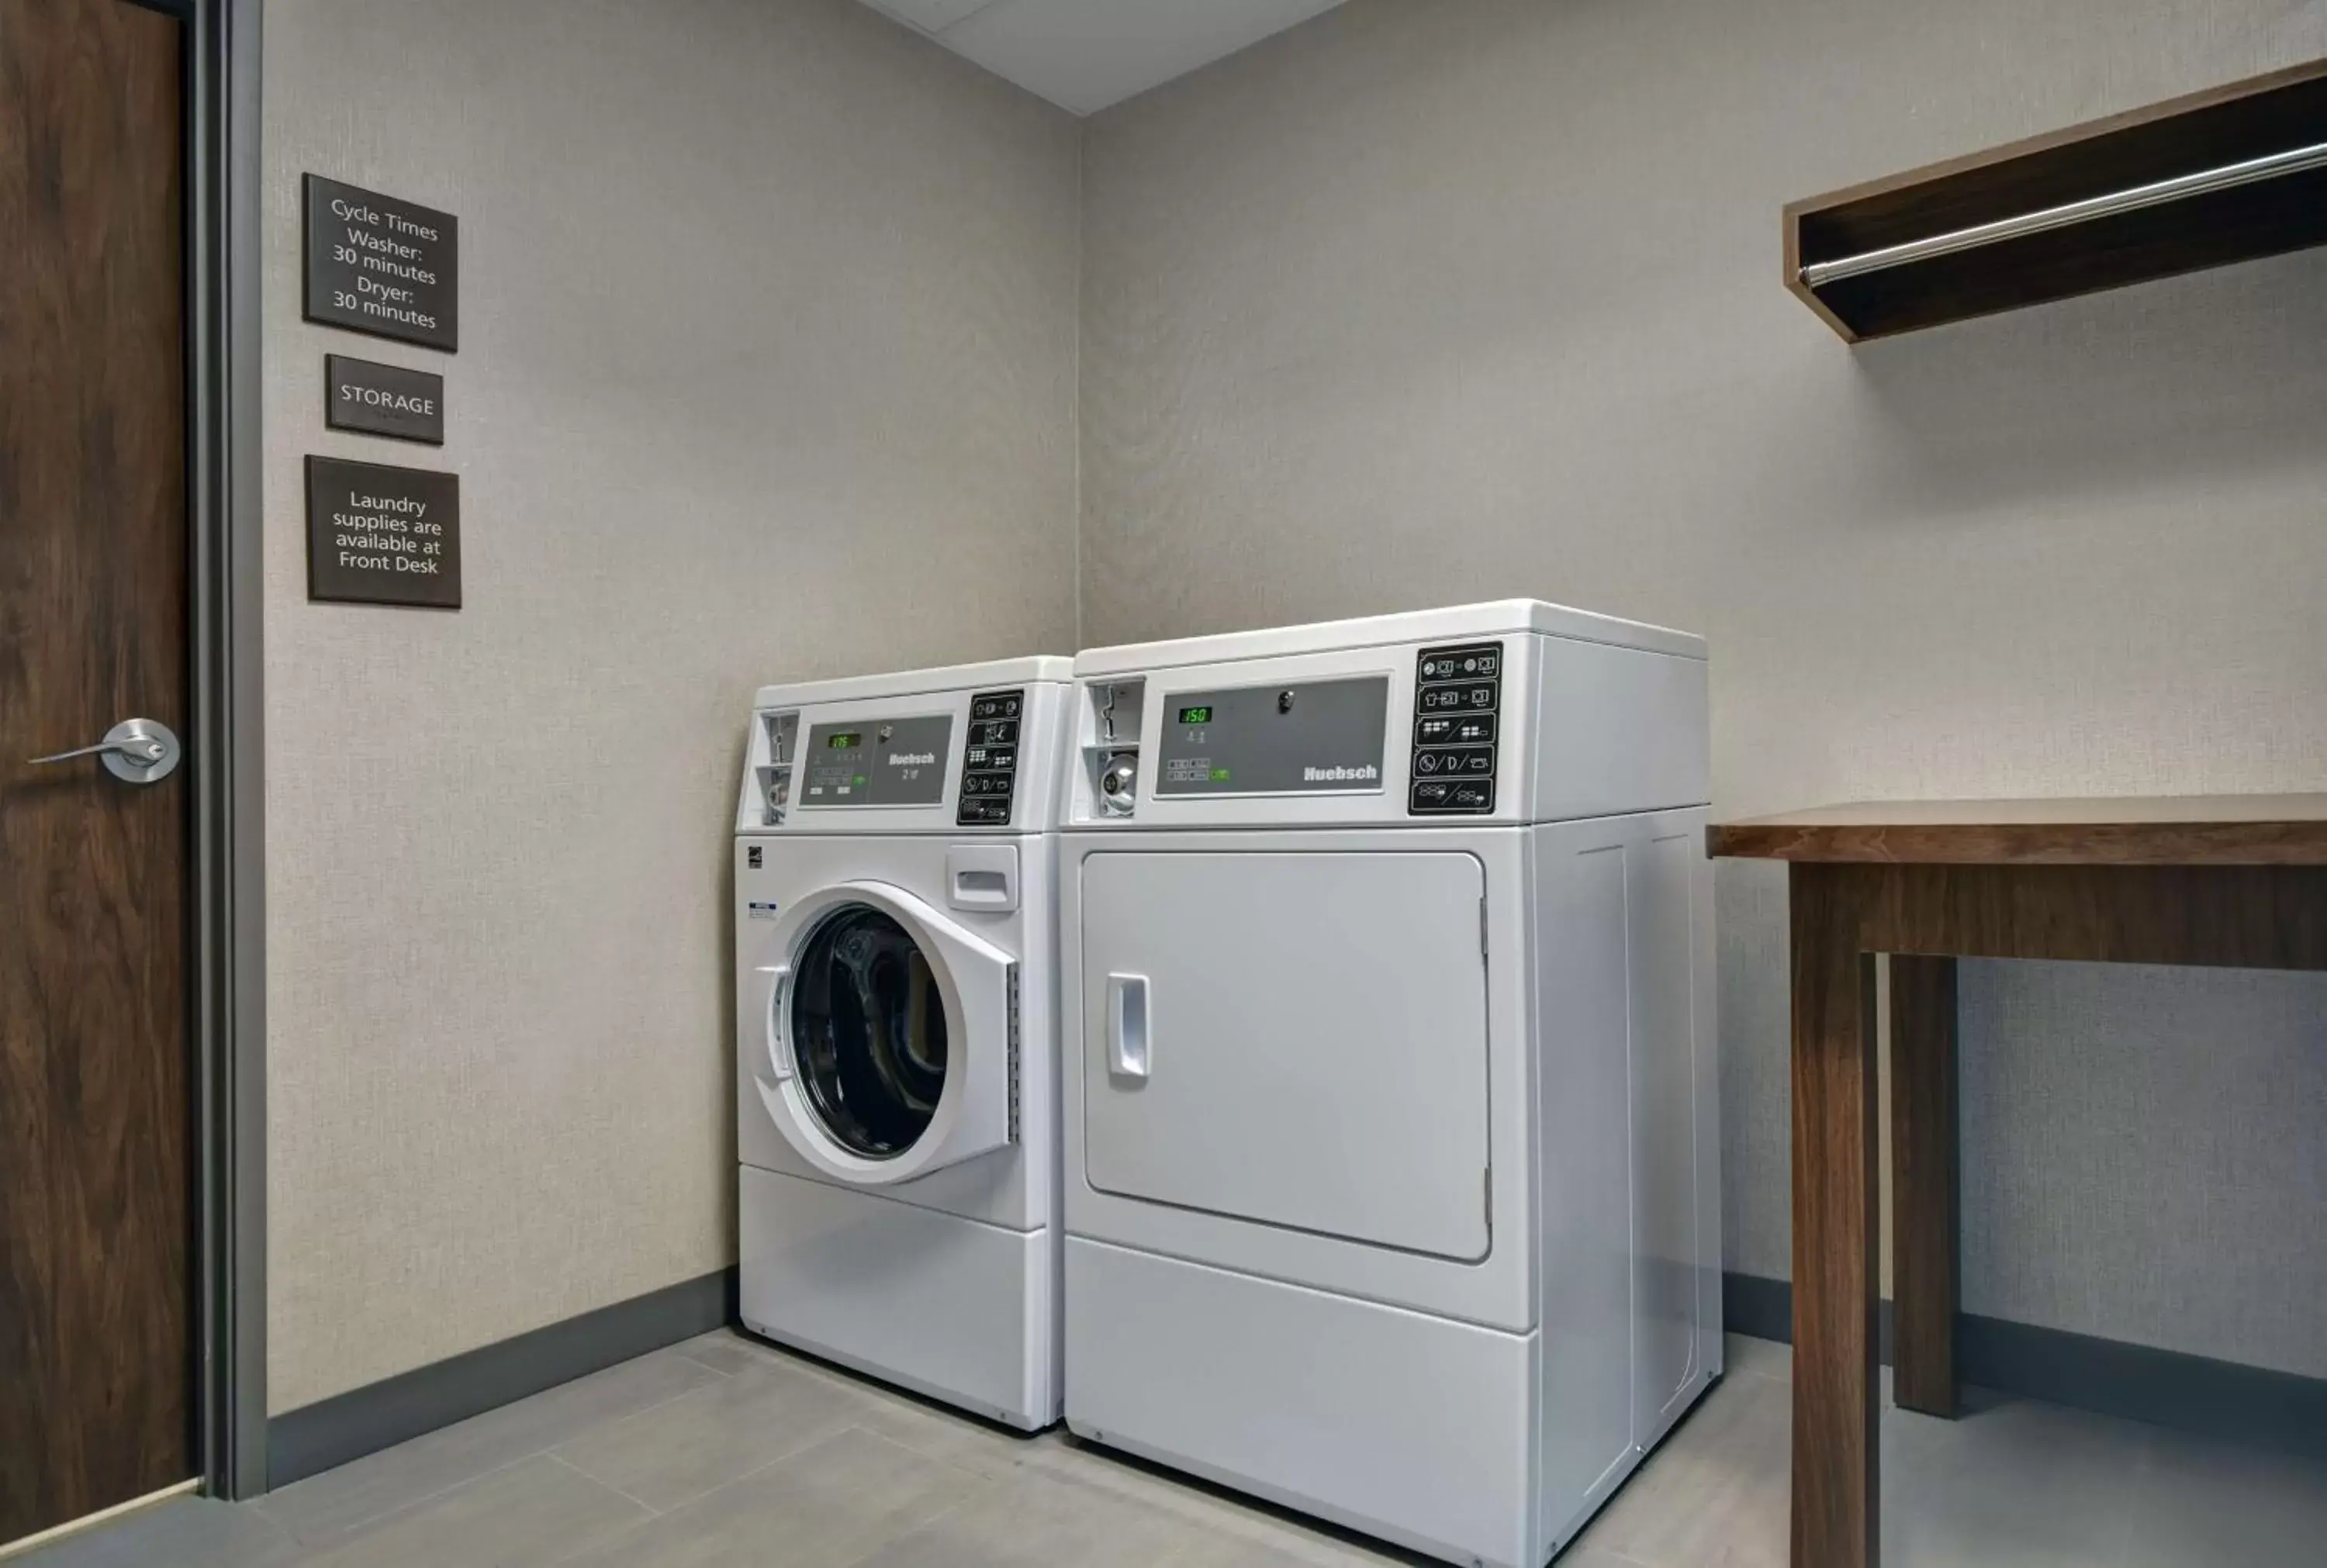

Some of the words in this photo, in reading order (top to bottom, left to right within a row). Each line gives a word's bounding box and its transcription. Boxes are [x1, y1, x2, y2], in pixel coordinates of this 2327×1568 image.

[331, 199, 379, 225] Cycle
[386, 213, 439, 241] Times
[347, 227, 423, 261] Washer:
[334, 245, 357, 264] 30
[363, 255, 436, 285] minutes
[358, 276, 414, 303] Dryer:
[334, 291, 357, 309] 30
[363, 302, 436, 329] minutes
[341, 385, 434, 415] STORAGE
[351, 491, 427, 517] Laundry
[333, 513, 408, 532] supplies
[413, 523, 442, 536] are
[336, 533, 417, 553] available
[423, 541, 441, 554] at
[340, 551, 390, 571] Front
[396, 555, 438, 574] Desk
[888, 753, 935, 765] Huebsch
[1304, 765, 1378, 782] Huebsch
